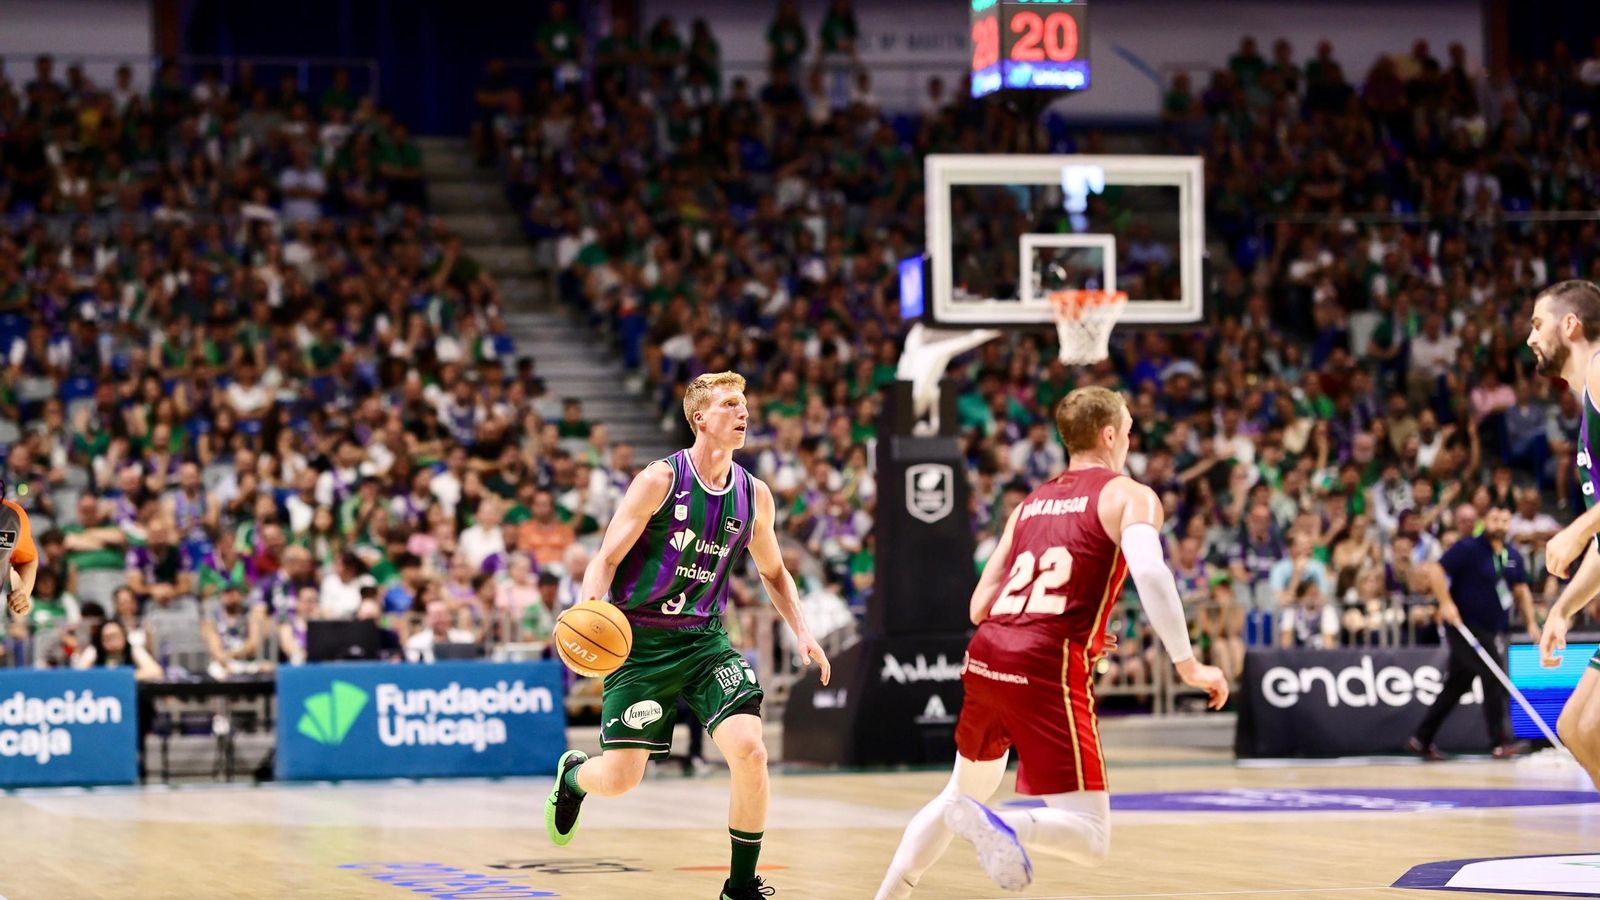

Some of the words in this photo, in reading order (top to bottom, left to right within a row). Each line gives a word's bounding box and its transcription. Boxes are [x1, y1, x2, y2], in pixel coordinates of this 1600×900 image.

[1010, 11, 1078, 62] 20
[695, 539, 730, 559] Unicaja
[675, 563, 716, 583] málaga
[990, 546, 1073, 616] 22
[661, 592, 687, 615] 9
[0, 689, 122, 726] dación
[376, 680, 553, 716] Fundación
[378, 712, 507, 753] Unicaja
